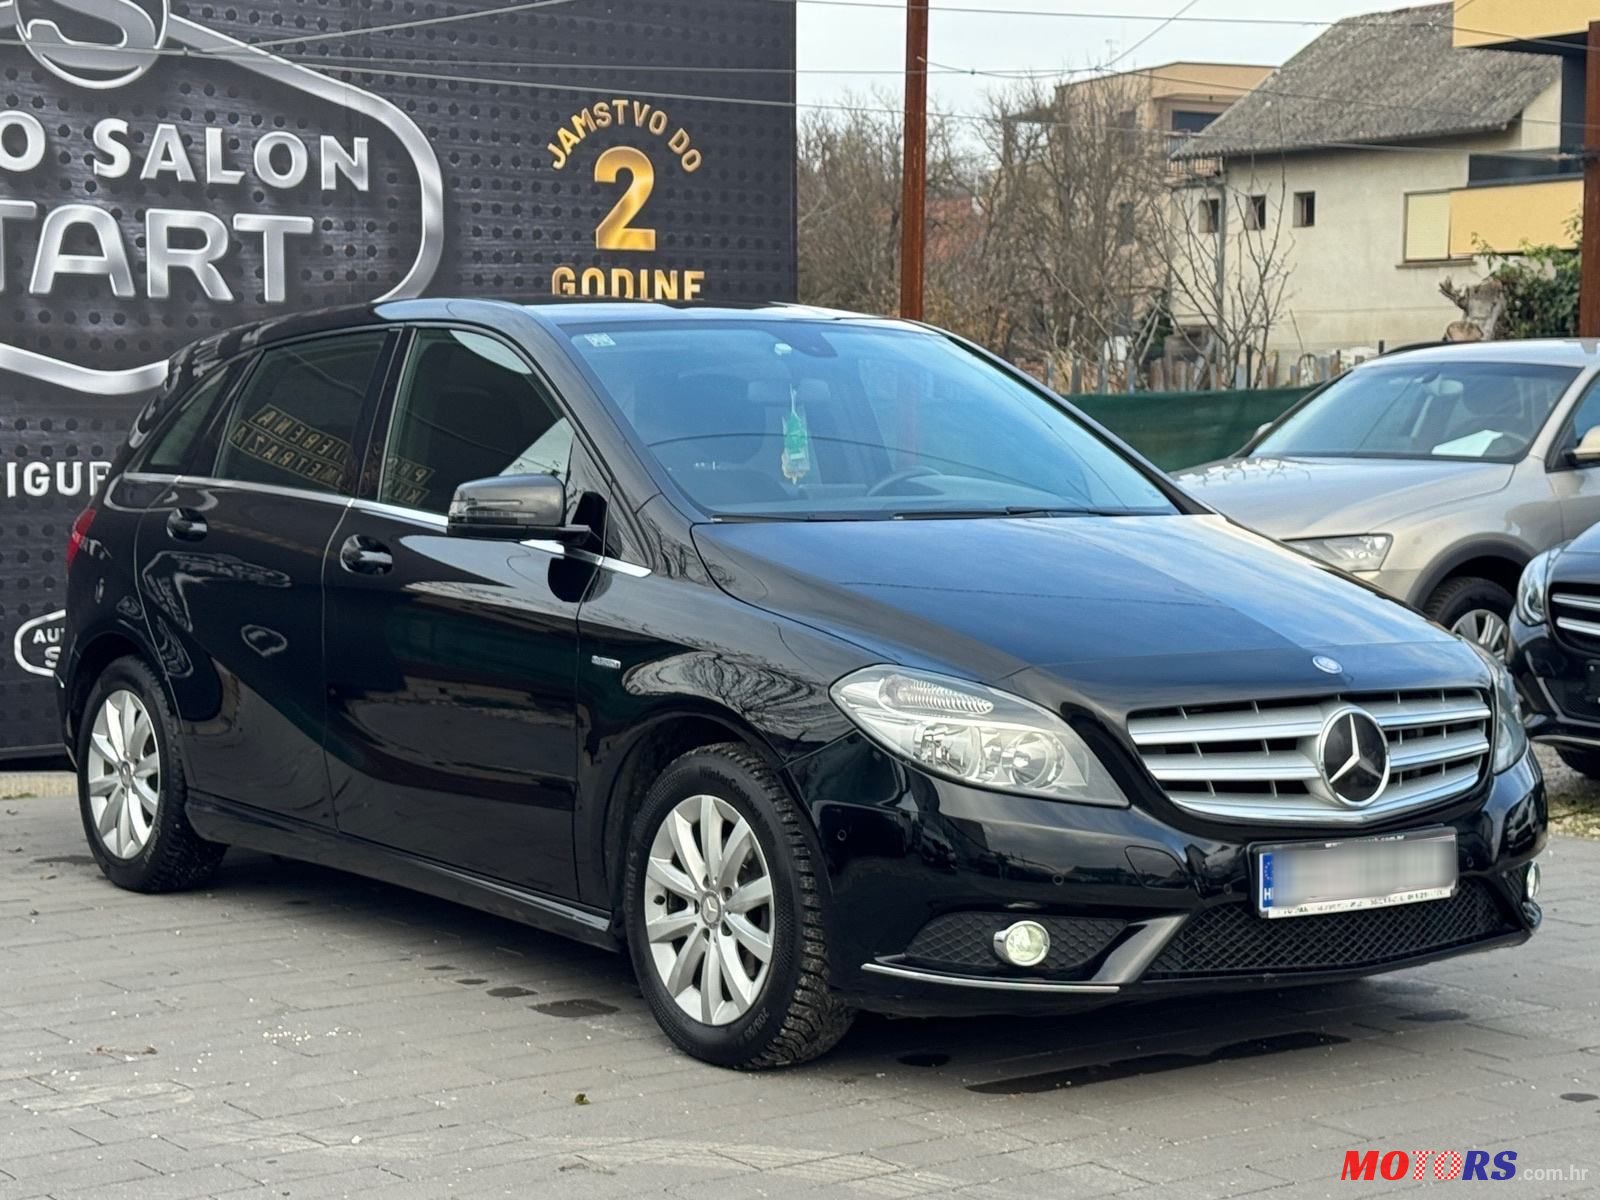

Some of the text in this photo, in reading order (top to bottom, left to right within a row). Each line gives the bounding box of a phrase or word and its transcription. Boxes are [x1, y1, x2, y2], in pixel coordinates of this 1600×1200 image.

[92, 118, 370, 191] SALON
[547, 99, 702, 173] JAMSTVO DO
[594, 145, 656, 251] 2
[551, 266, 705, 301] GODINE
